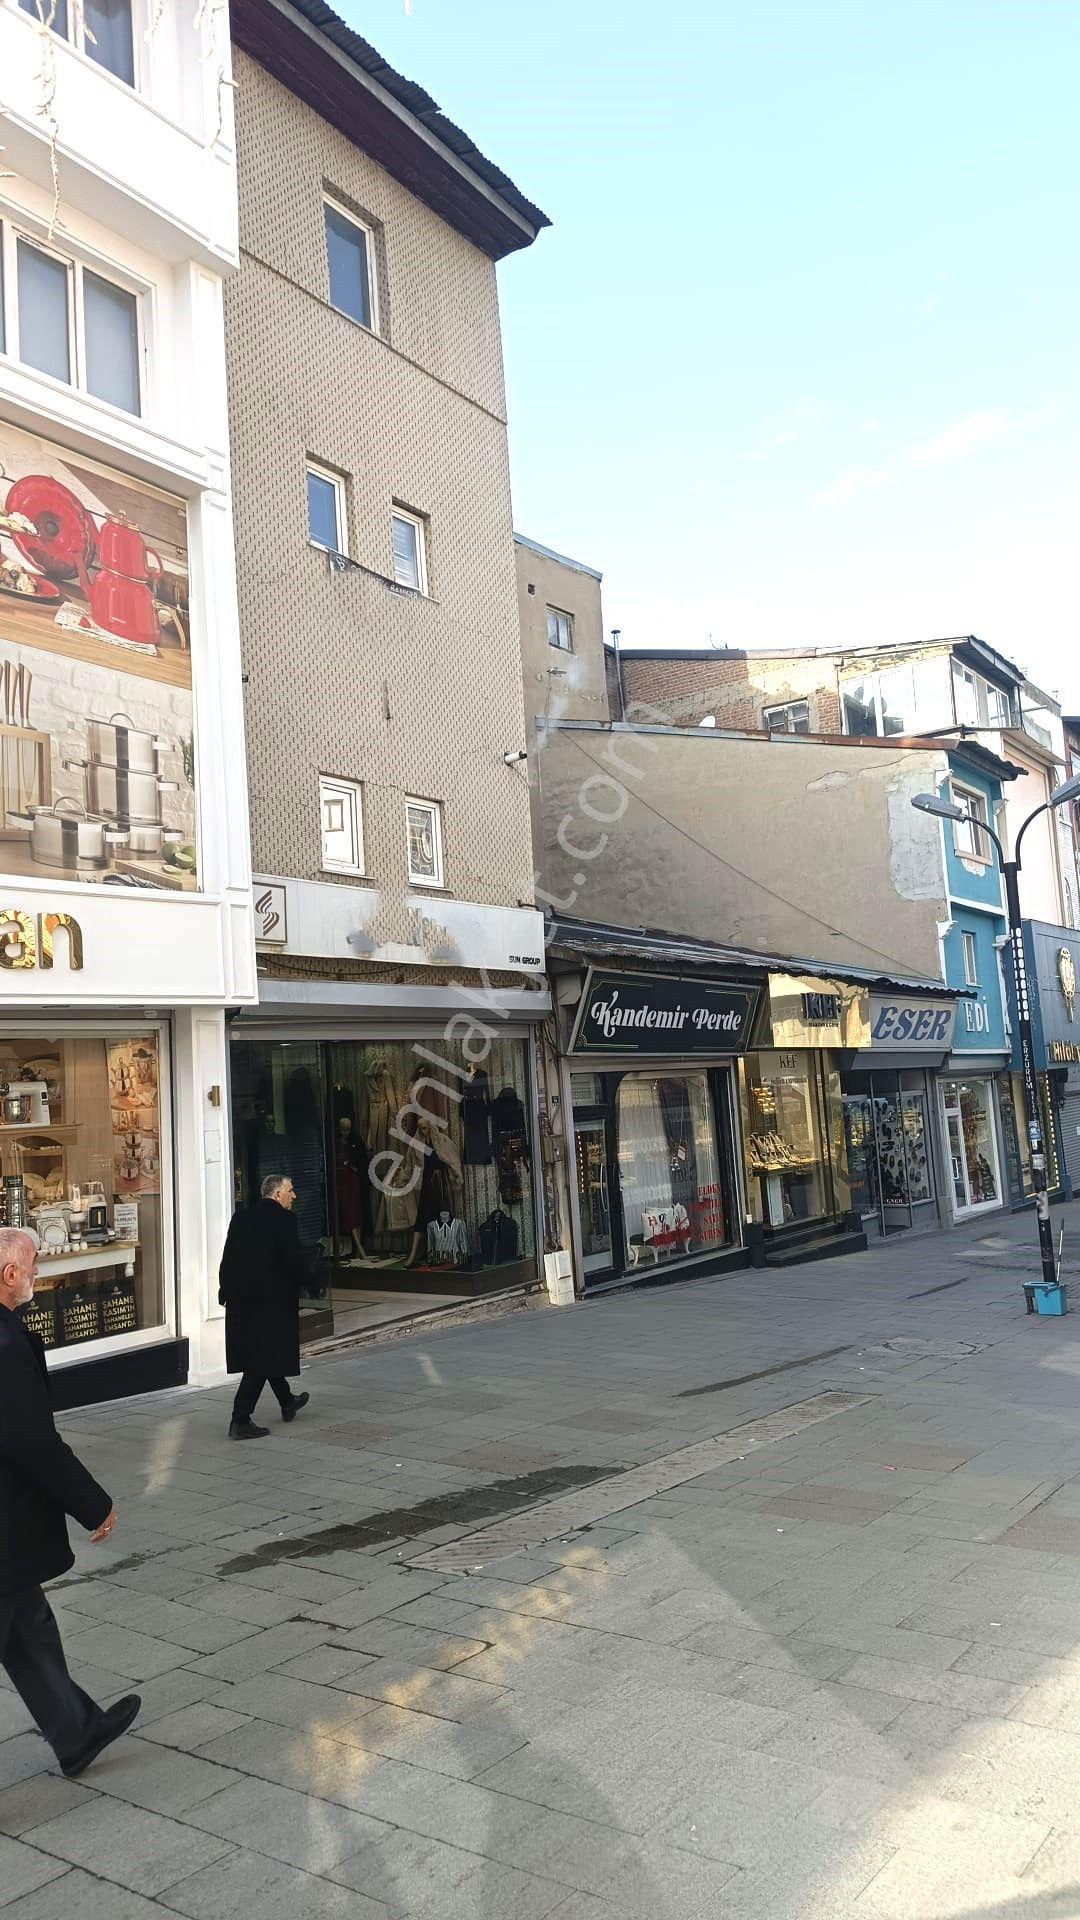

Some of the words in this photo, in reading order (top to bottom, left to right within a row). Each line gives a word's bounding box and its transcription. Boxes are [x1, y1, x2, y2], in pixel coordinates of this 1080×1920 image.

[508, 955, 521, 964] SUN
[522, 956, 541, 966] GROUP
[591, 990, 690, 1038] Kandemir
[692, 1008, 742, 1031] Perde
[871, 1006, 952, 1041] ESER
[1022, 1039, 1034, 1089] ERZURUM
